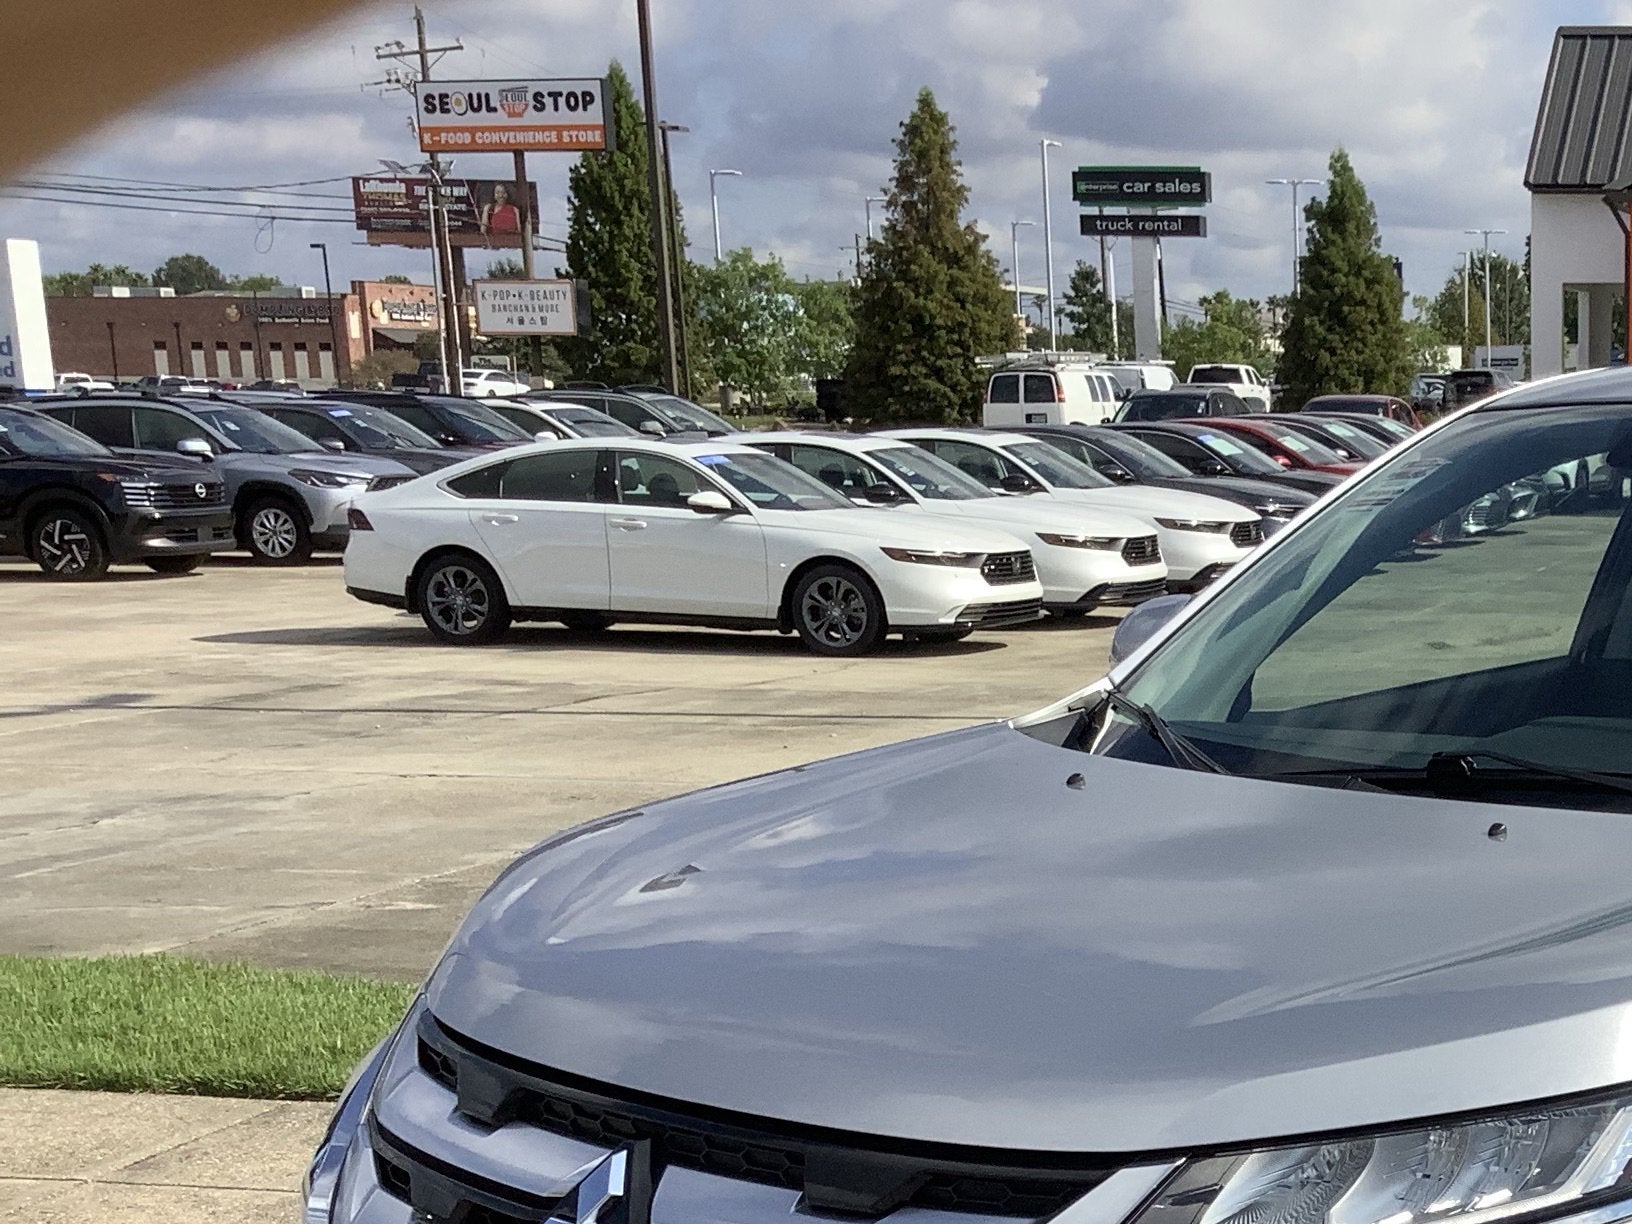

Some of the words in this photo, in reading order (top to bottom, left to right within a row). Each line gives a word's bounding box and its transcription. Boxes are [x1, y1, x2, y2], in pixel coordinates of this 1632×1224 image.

[423, 91, 498, 116] SEOUL
[532, 91, 595, 112] STOP
[422, 132, 472, 145] K-FOOD
[475, 131, 558, 145] CONVENIENCE
[562, 130, 603, 143] STORE
[1122, 181, 1151, 193] car
[1155, 178, 1201, 193] sales
[1095, 218, 1134, 231] truck
[1138, 218, 1182, 231] rental
